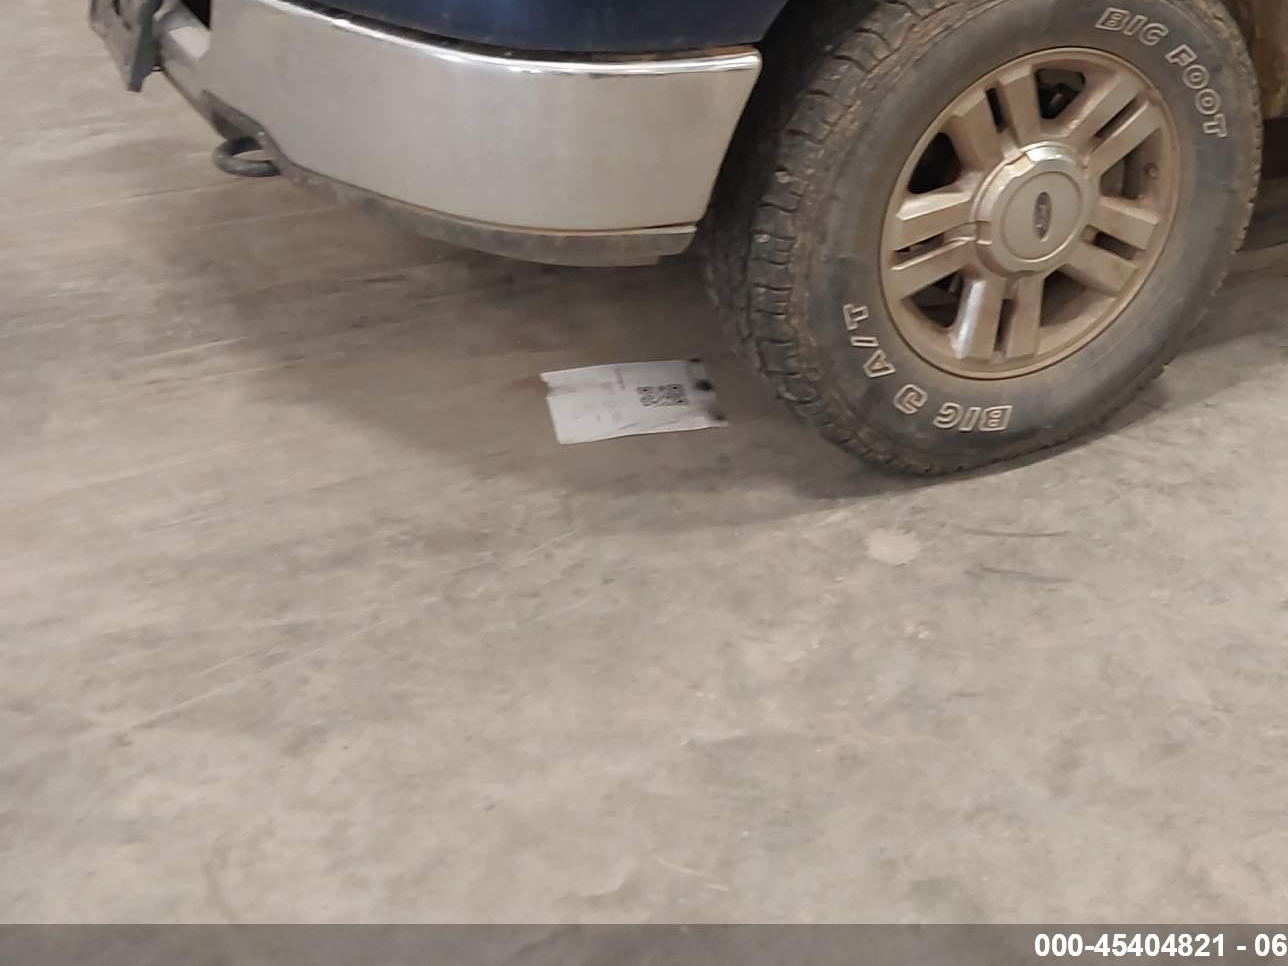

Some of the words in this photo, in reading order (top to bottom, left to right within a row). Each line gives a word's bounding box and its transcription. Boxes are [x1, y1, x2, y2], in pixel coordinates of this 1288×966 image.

[1095, 7, 1169, 46] BIG
[1164, 44, 1228, 138] FOOT
[842, 303, 896, 378] A/T
[933, 402, 1013, 432] BIG
